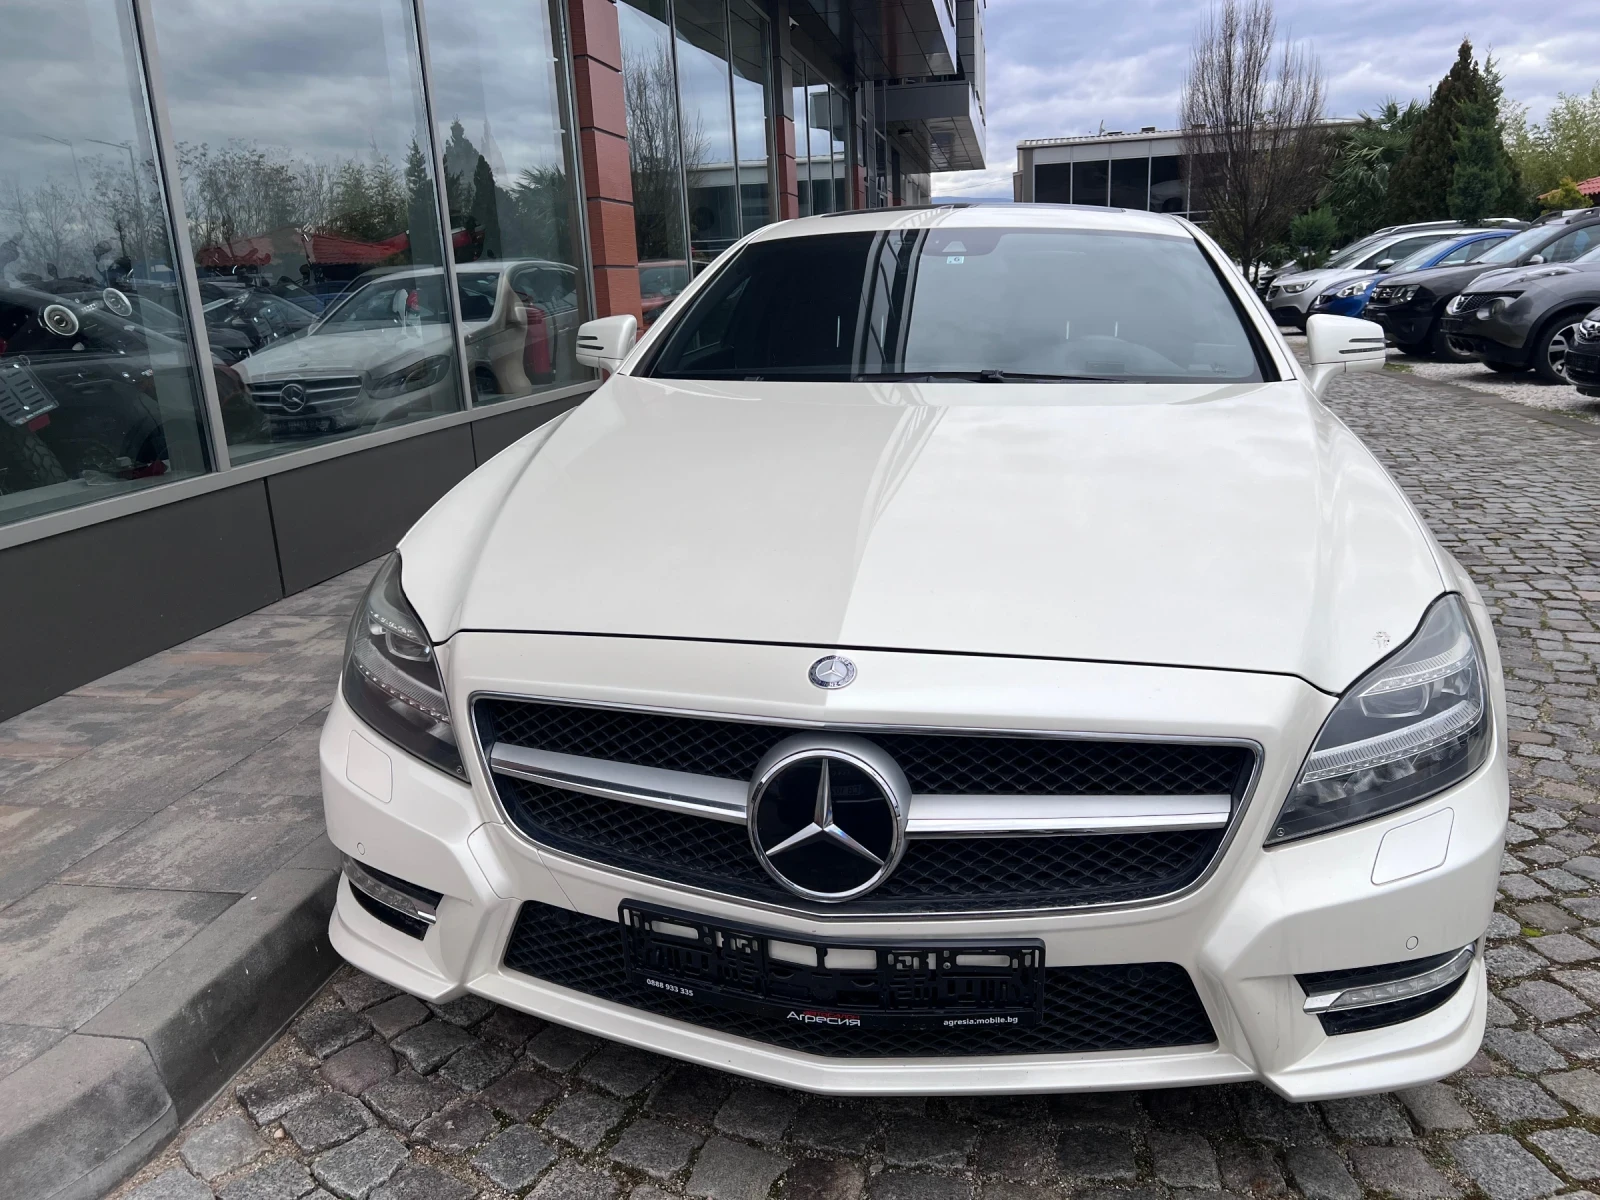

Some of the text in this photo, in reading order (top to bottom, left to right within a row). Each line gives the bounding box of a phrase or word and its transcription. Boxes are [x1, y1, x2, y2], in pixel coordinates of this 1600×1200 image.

[646, 978, 694, 997] 0888 933 335
[786, 1010, 861, 1027] Агресия
[943, 1016, 1019, 1027] agresia.mobile.bg
